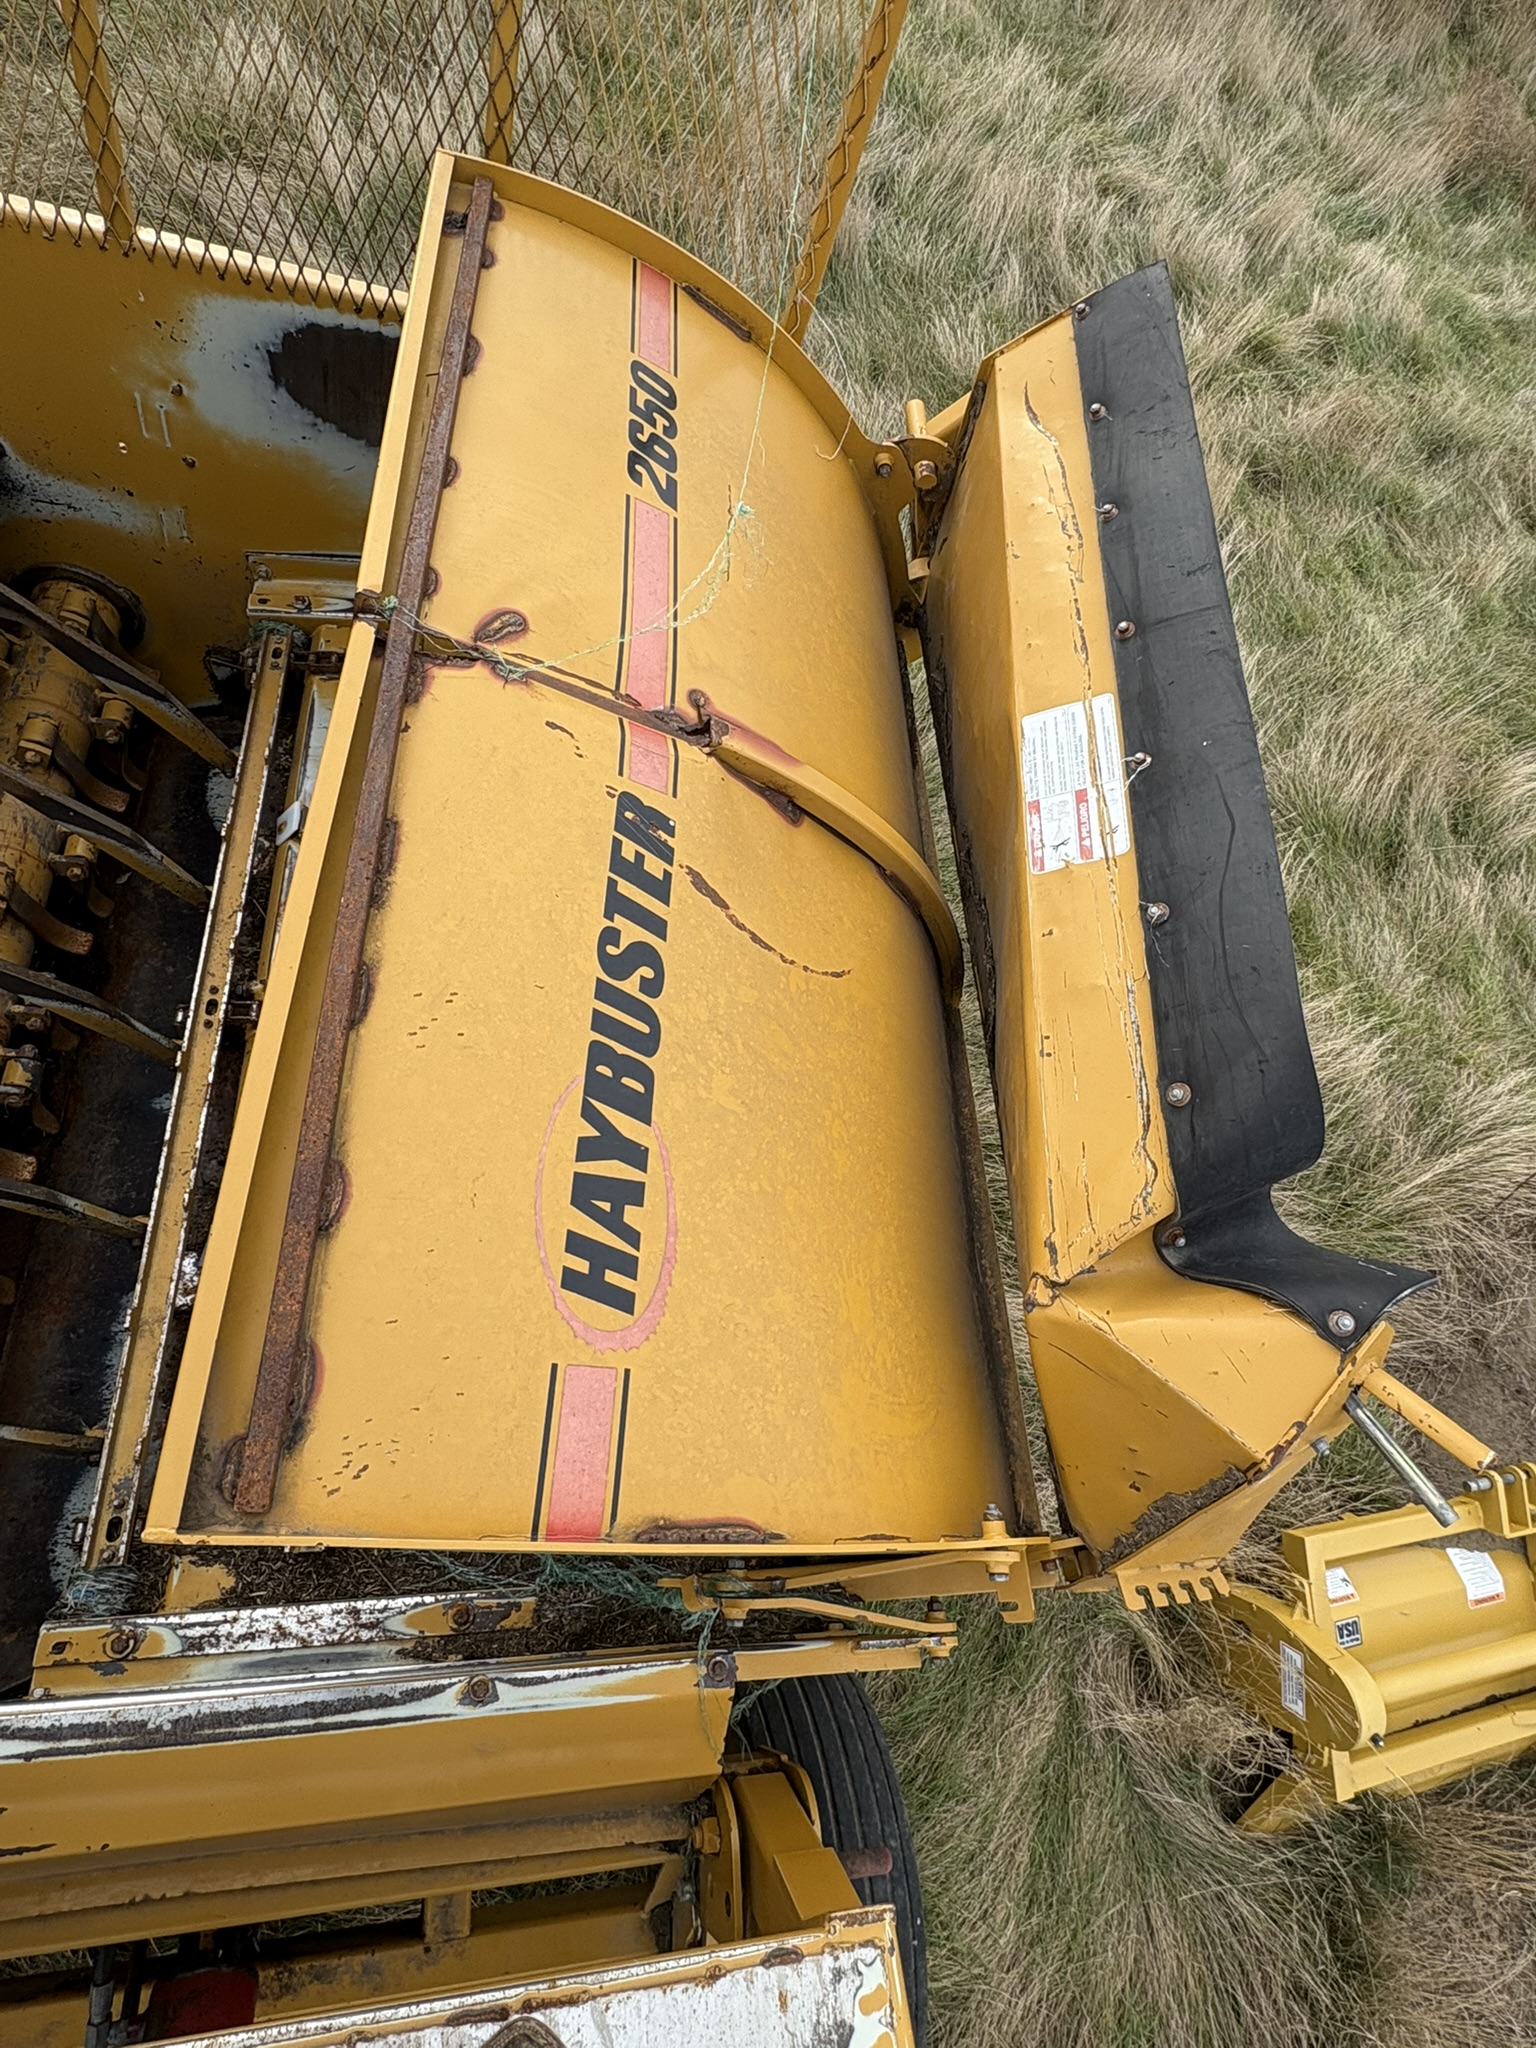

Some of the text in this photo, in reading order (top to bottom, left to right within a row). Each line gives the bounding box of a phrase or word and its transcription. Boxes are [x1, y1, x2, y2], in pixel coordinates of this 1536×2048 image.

[627, 360, 678, 512] 2650
[1079, 802, 1089, 838] PELIGRO
[561, 791, 676, 1316] HAYBUSTER
[1337, 1620, 1360, 1640] USA
